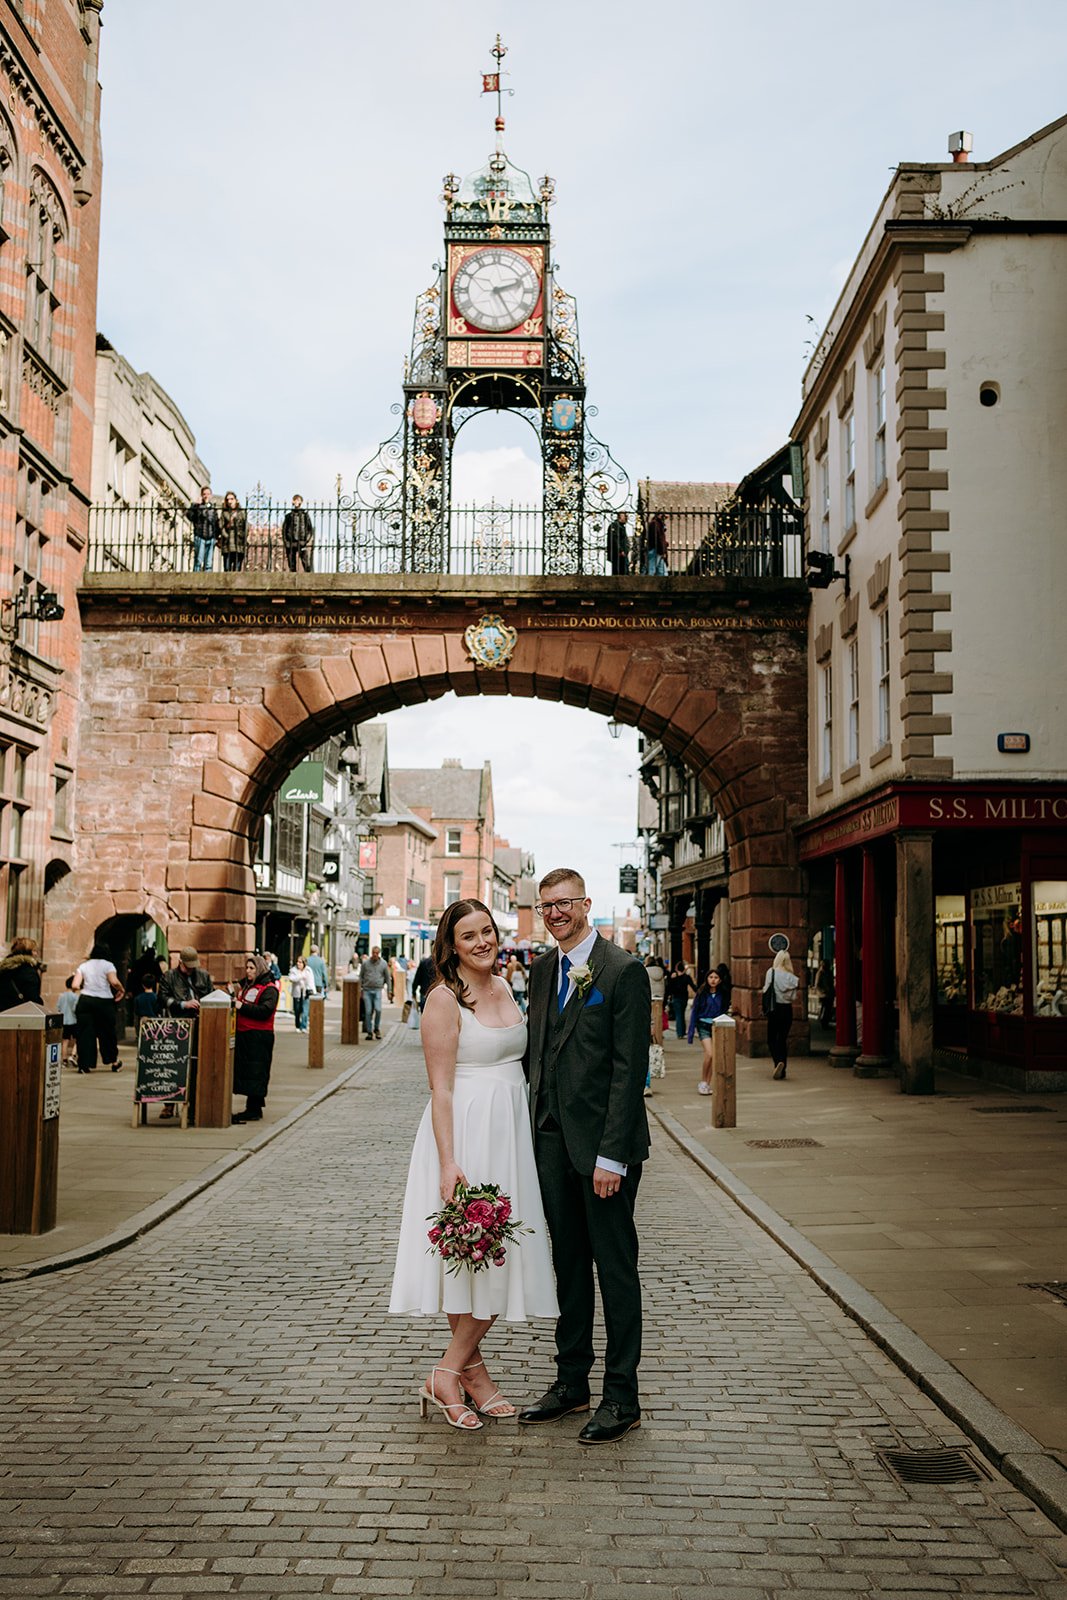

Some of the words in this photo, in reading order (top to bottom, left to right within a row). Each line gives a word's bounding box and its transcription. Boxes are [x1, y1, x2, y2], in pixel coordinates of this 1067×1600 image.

[450, 317, 467, 334] 18
[523, 318, 543, 335] 97
[179, 614, 215, 624] BEGUN
[308, 615, 337, 626] JOHN
[338, 615, 390, 625] KELSALL
[285, 788, 319, 800] Clarks
[929, 797, 974, 819] S.S.
[51, 1046, 57, 1062] P
